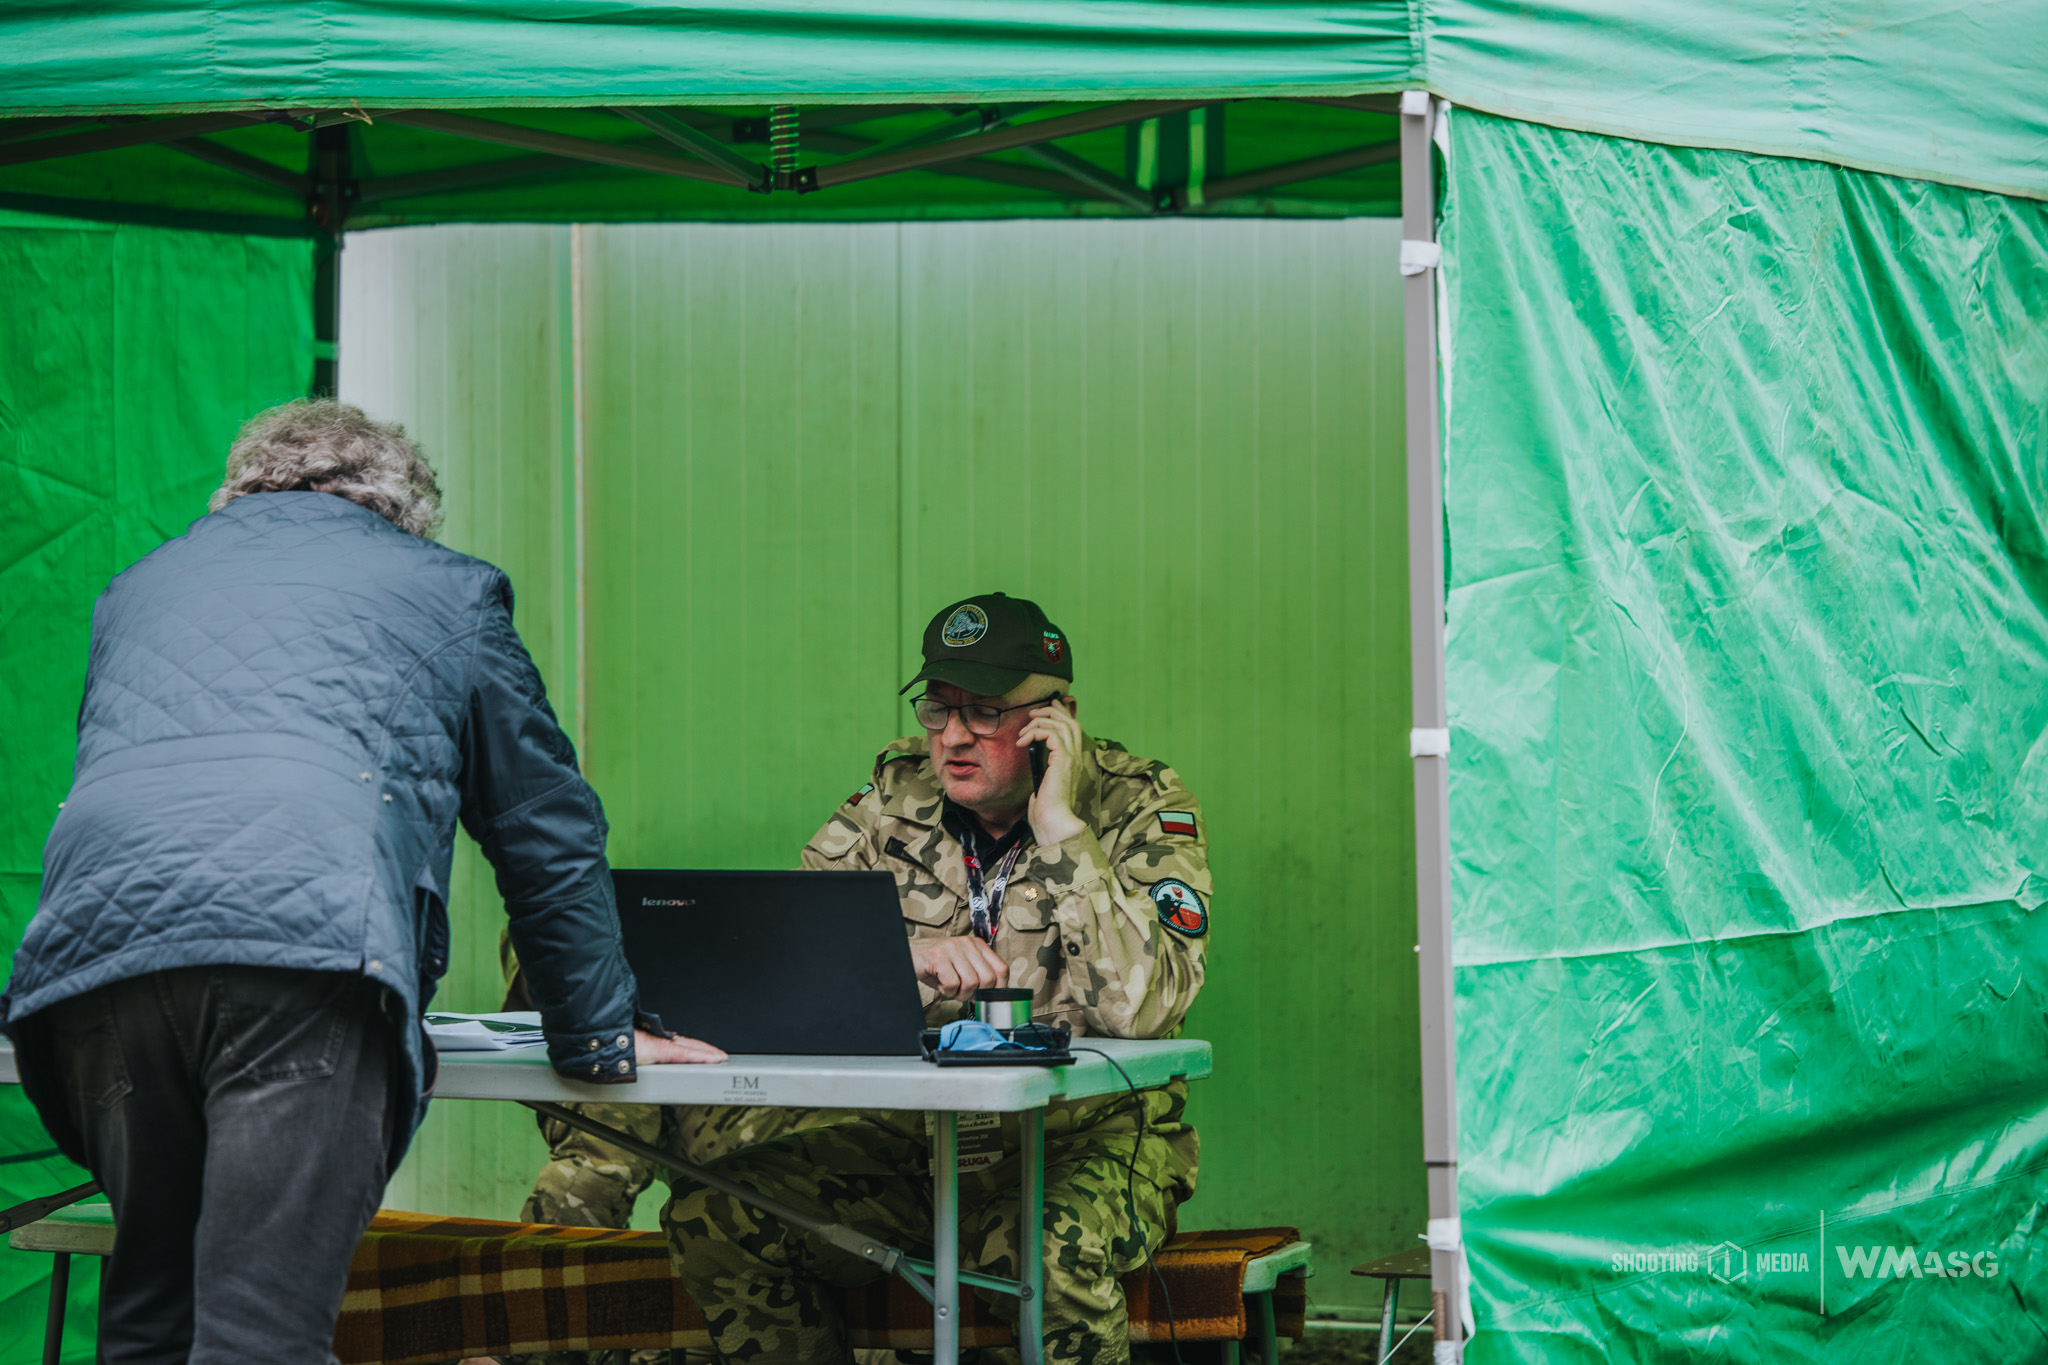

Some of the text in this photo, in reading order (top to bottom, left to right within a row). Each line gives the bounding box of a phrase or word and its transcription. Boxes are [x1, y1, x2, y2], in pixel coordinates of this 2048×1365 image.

[642, 897, 696, 906] lenovo
[732, 1076, 760, 1089] EM
[957, 1156, 990, 1167] SŁUGA
